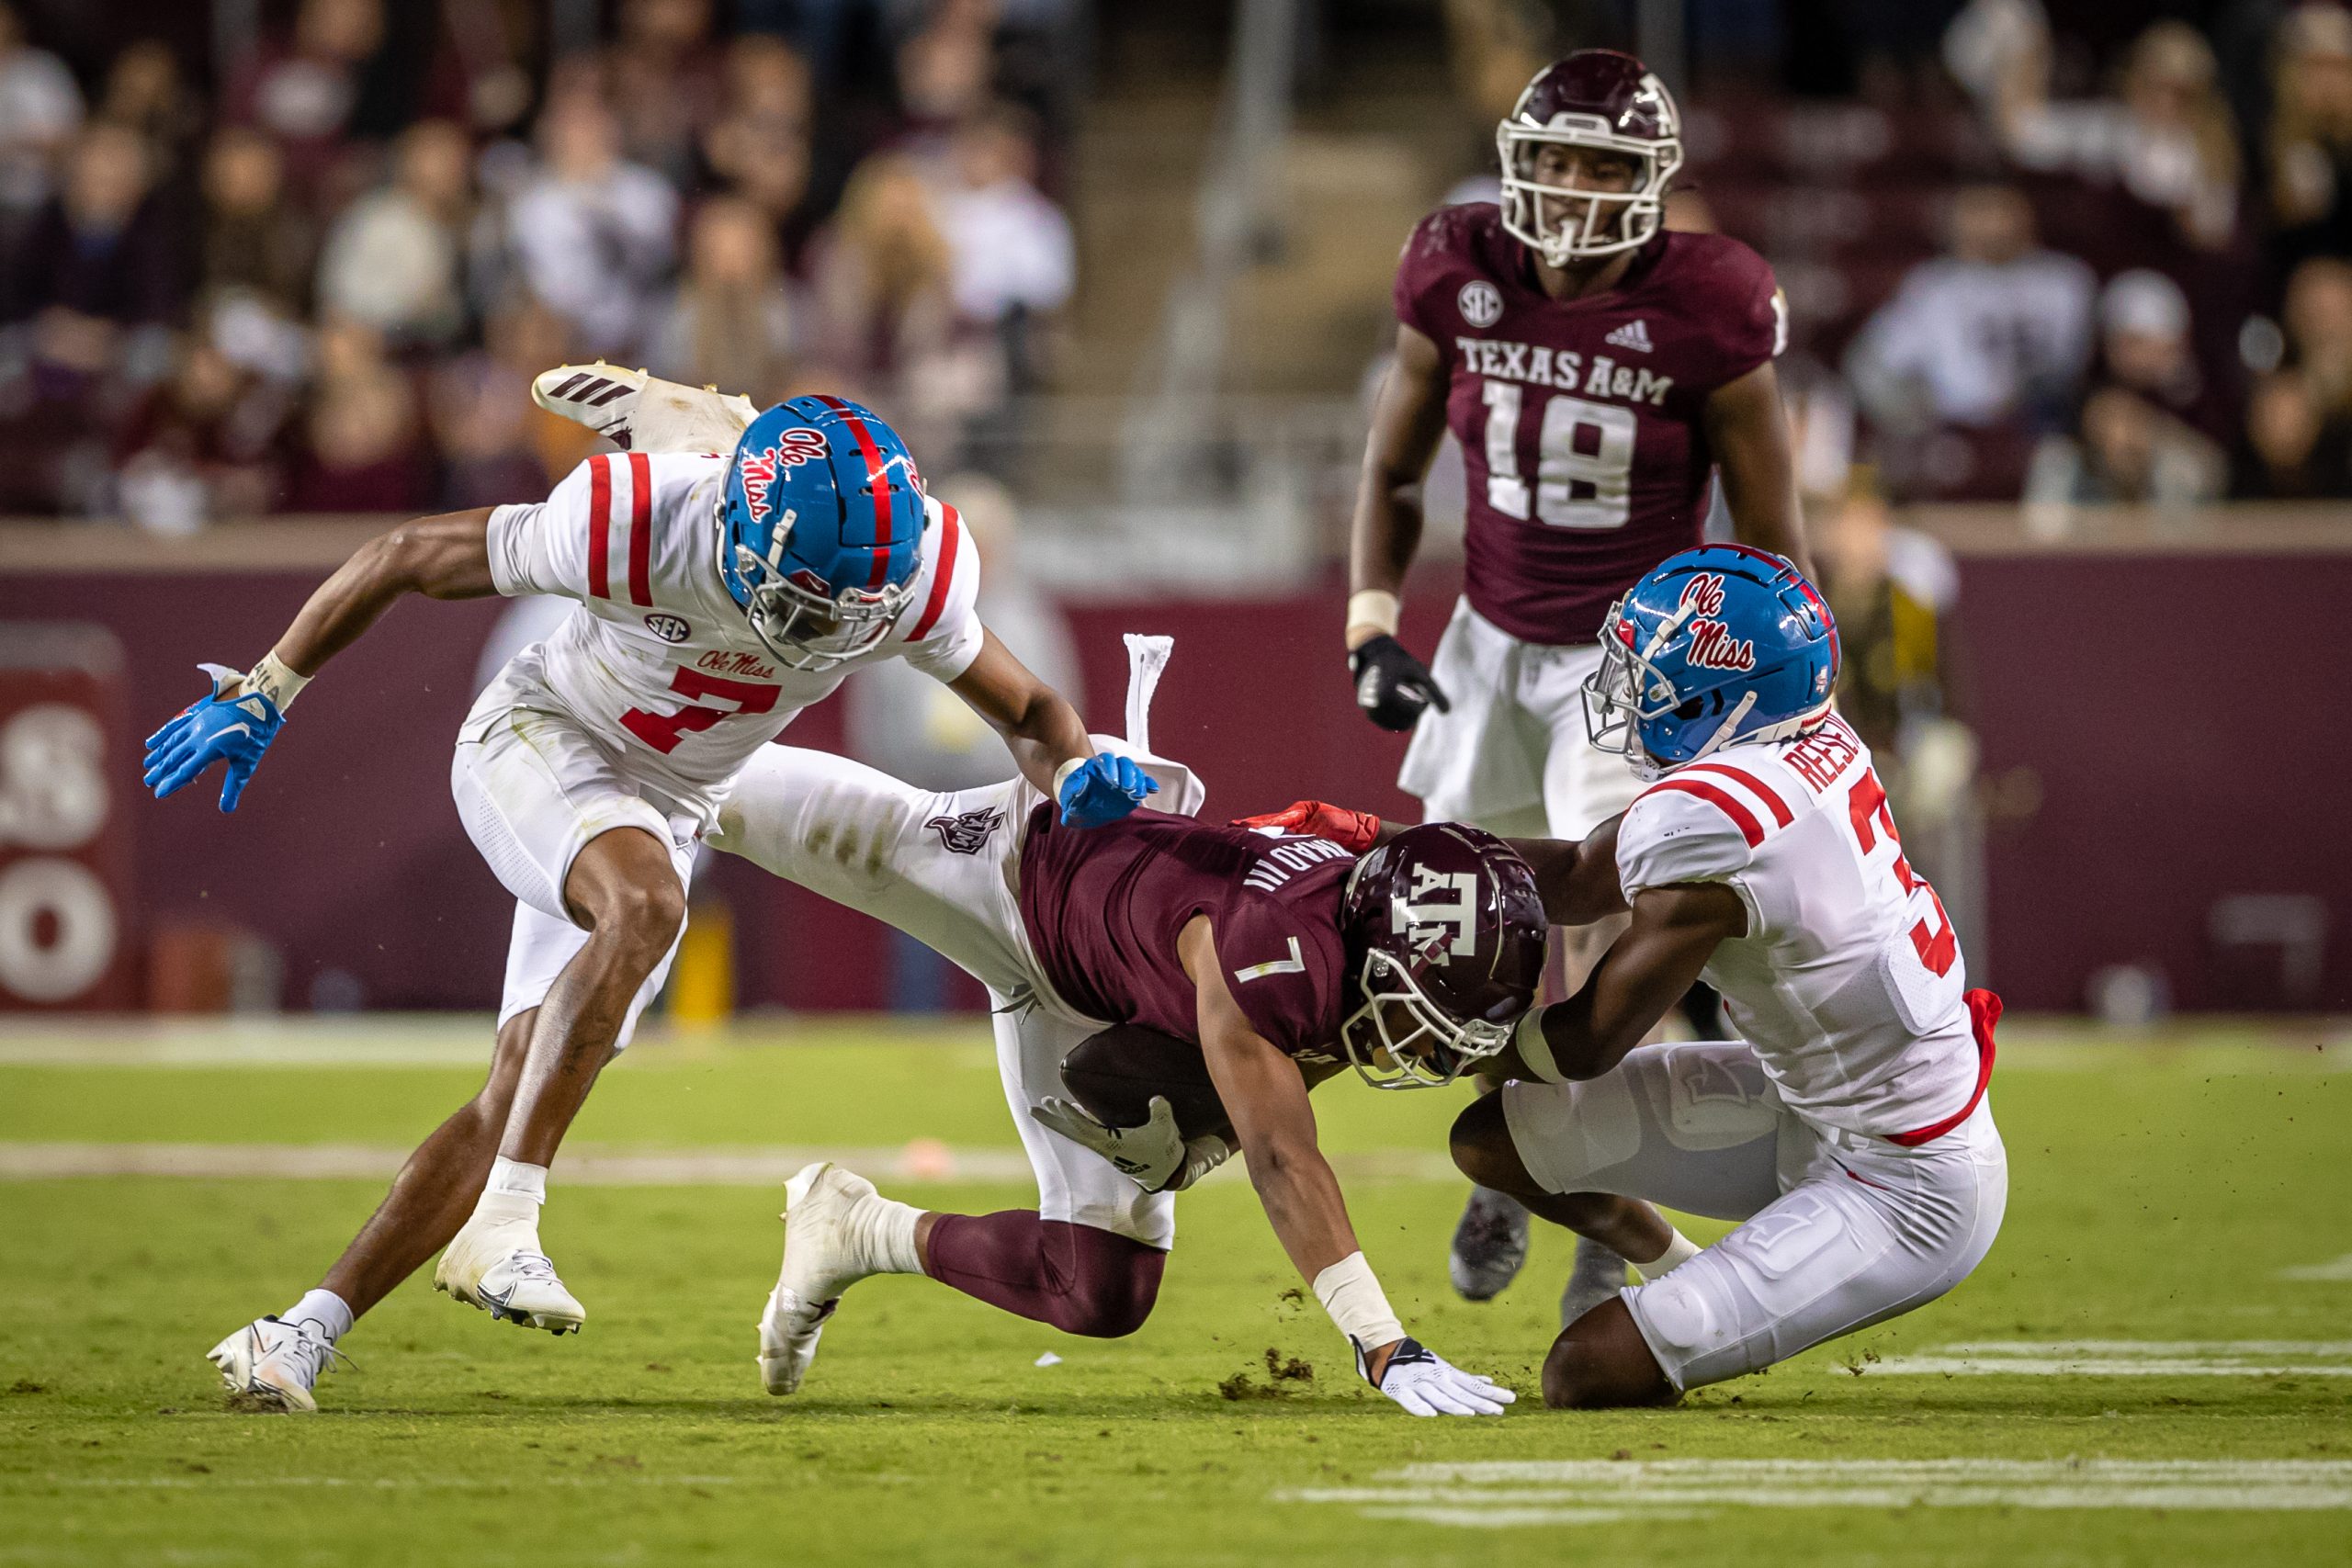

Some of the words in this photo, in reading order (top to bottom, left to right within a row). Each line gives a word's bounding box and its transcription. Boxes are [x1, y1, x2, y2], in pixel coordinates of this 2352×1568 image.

[1455, 336, 1582, 389] TEXAS
[1585, 355, 1674, 405] A&M
[779, 427, 827, 466] Ole
[1482, 379, 1638, 528] 18
[741, 447, 777, 524] Miss
[1679, 572, 1725, 617] Ole
[646, 615, 690, 642] SEC
[1686, 618, 1756, 671] Miss
[696, 650, 729, 671] Ole
[727, 651, 775, 679] Miss
[618, 664, 783, 755] 7
[1243, 859, 1291, 892] III
[1849, 766, 1956, 979] 3
[1234, 936, 1306, 984] 7
